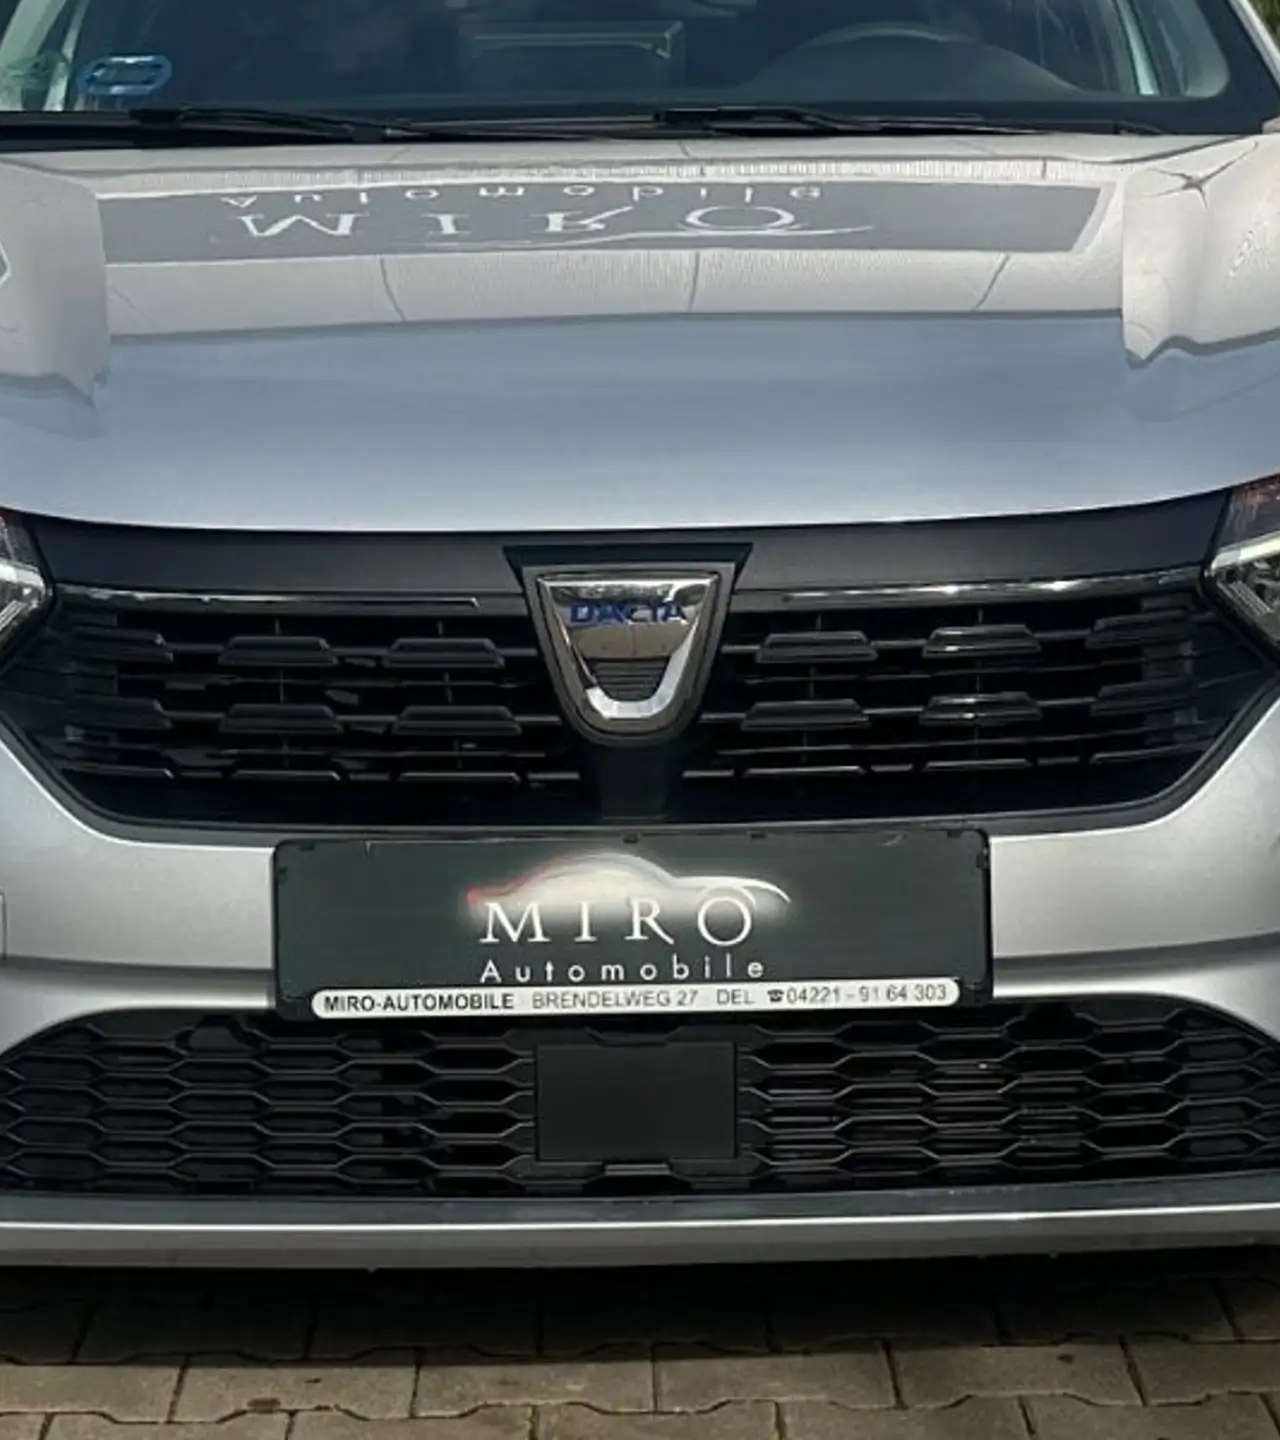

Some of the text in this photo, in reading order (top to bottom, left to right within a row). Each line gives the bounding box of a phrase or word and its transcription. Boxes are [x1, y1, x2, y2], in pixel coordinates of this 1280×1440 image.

[478, 894, 753, 947] MIRO
[479, 954, 765, 984] Automobile
[323, 992, 515, 1012] MIRO-AUTOMOBILE
[532, 990, 671, 1010] BRENDELWEG
[675, 990, 699, 1006] 27
[716, 988, 756, 1006] DEL
[859, 985, 879, 1003] 91
[886, 984, 909, 1002] 64
[914, 983, 947, 1001] 303
